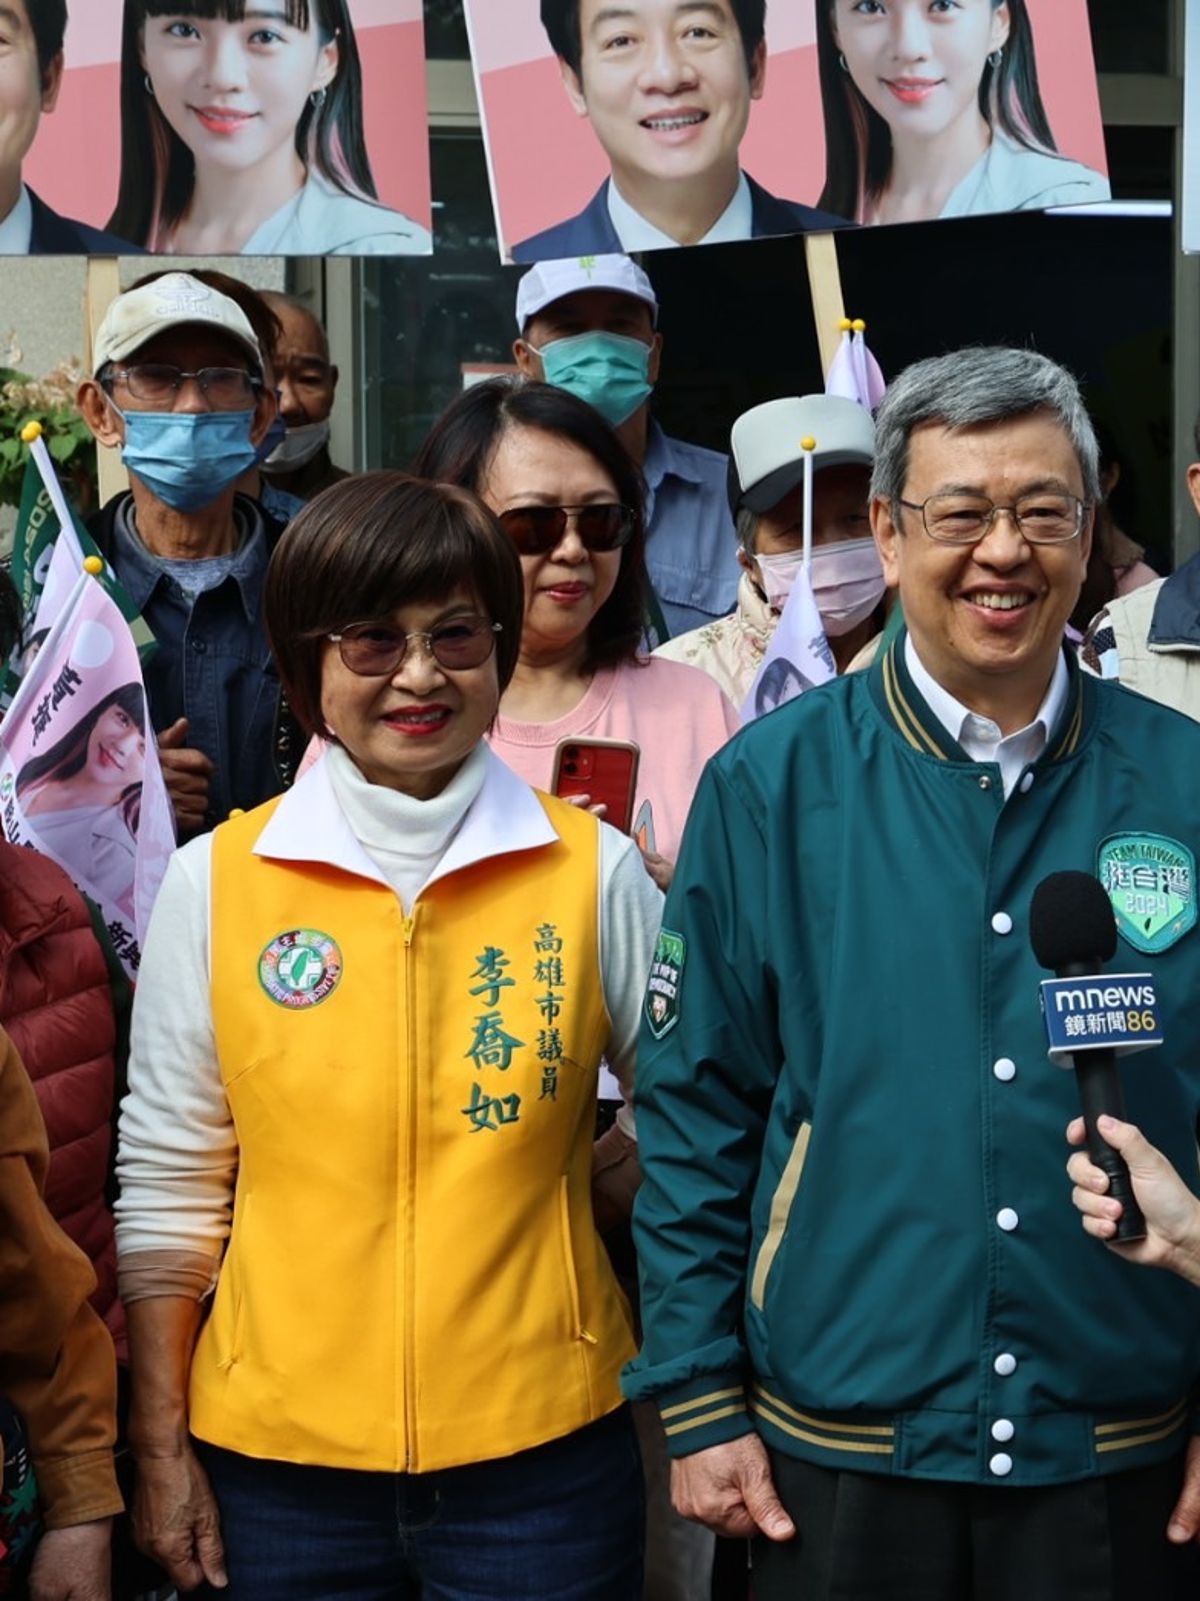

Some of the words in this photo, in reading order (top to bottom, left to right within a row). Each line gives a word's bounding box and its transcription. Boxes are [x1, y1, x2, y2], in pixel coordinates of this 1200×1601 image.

[1107, 844, 1136, 862] TEAM
[1141, 844, 1184, 867] TAIWAN
[1125, 894, 1169, 916] 2024
[533, 922, 567, 1102] 高雄市議員
[1055, 985, 1156, 1012] mnews
[461, 946, 527, 1133] 李喬如
